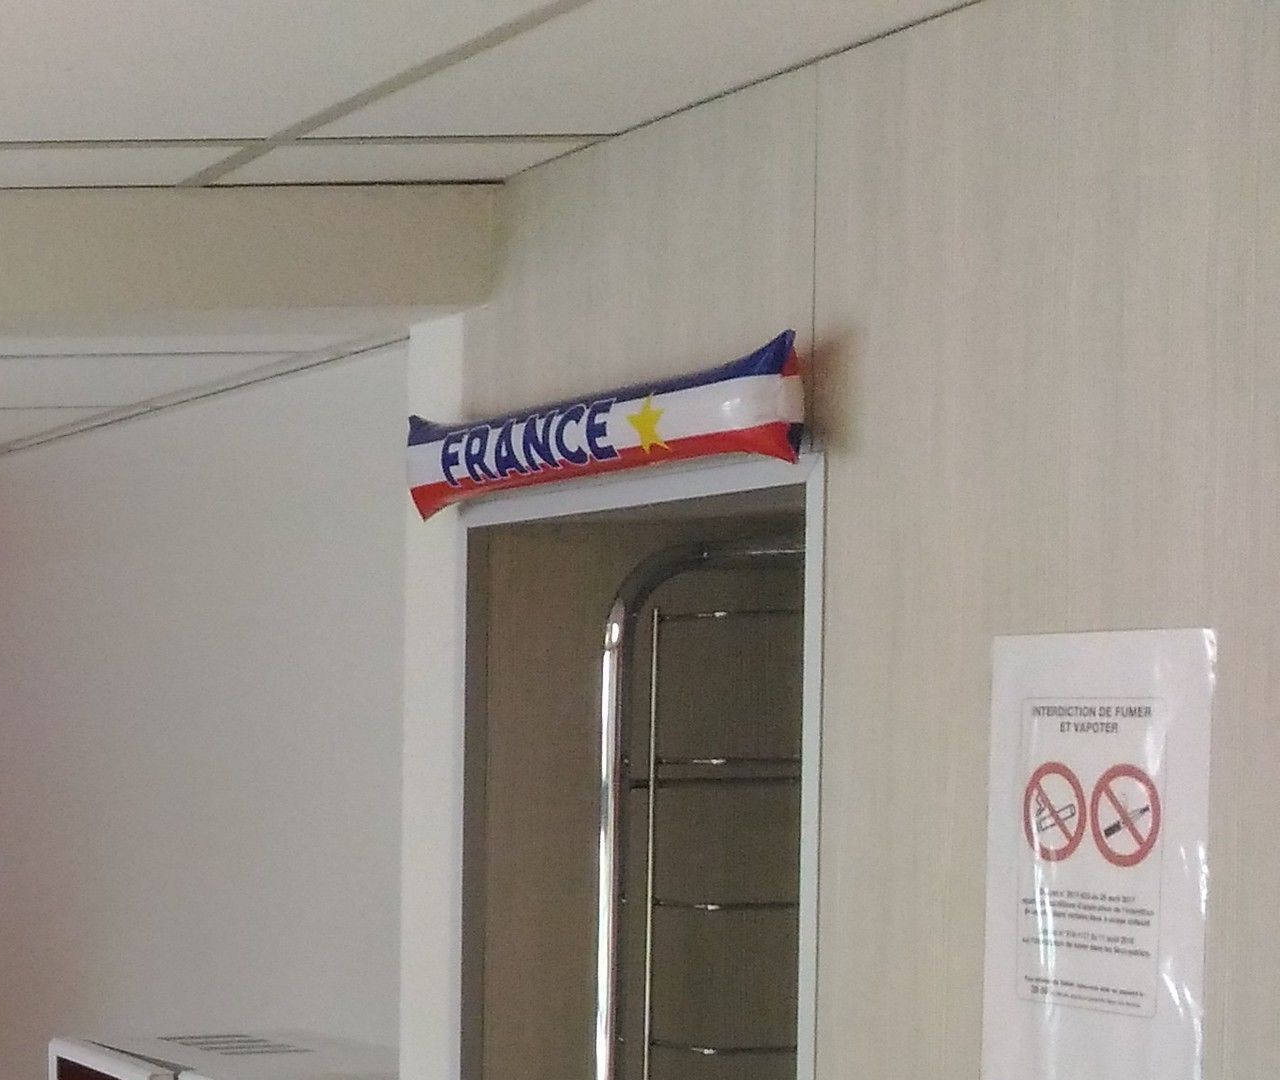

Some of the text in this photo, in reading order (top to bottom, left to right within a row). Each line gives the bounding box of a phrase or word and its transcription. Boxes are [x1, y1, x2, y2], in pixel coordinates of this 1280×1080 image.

[440, 397, 620, 487] FRANCE
[1032, 705, 1152, 718] INTERDICTION DE FUMER
[1060, 721, 1119, 733] ET VAPOTER
